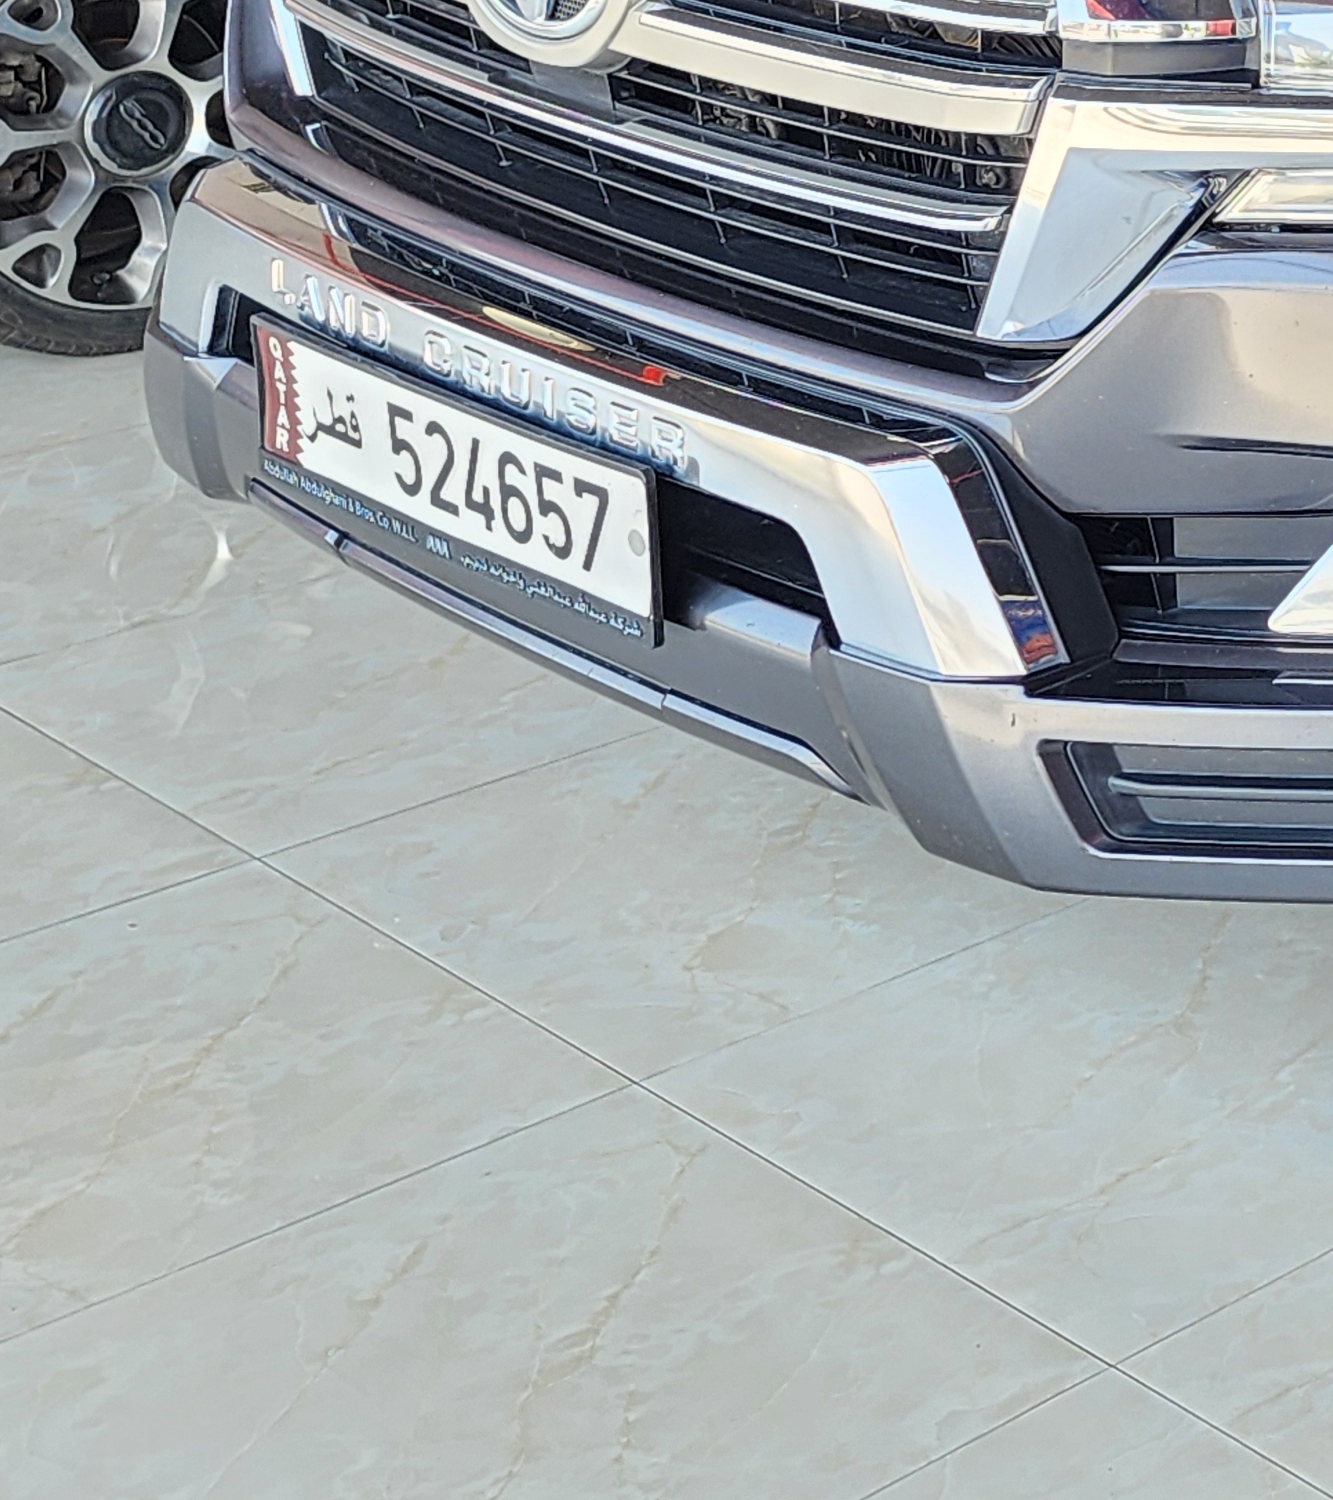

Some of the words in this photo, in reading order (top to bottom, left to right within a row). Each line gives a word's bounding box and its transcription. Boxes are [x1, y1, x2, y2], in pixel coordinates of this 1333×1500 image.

[268, 336, 291, 453] QATAR
[271, 258, 390, 348] LAND
[422, 330, 687, 471] CRUISER
[301, 386, 363, 449] قطر
[387, 401, 609, 573] 524657
